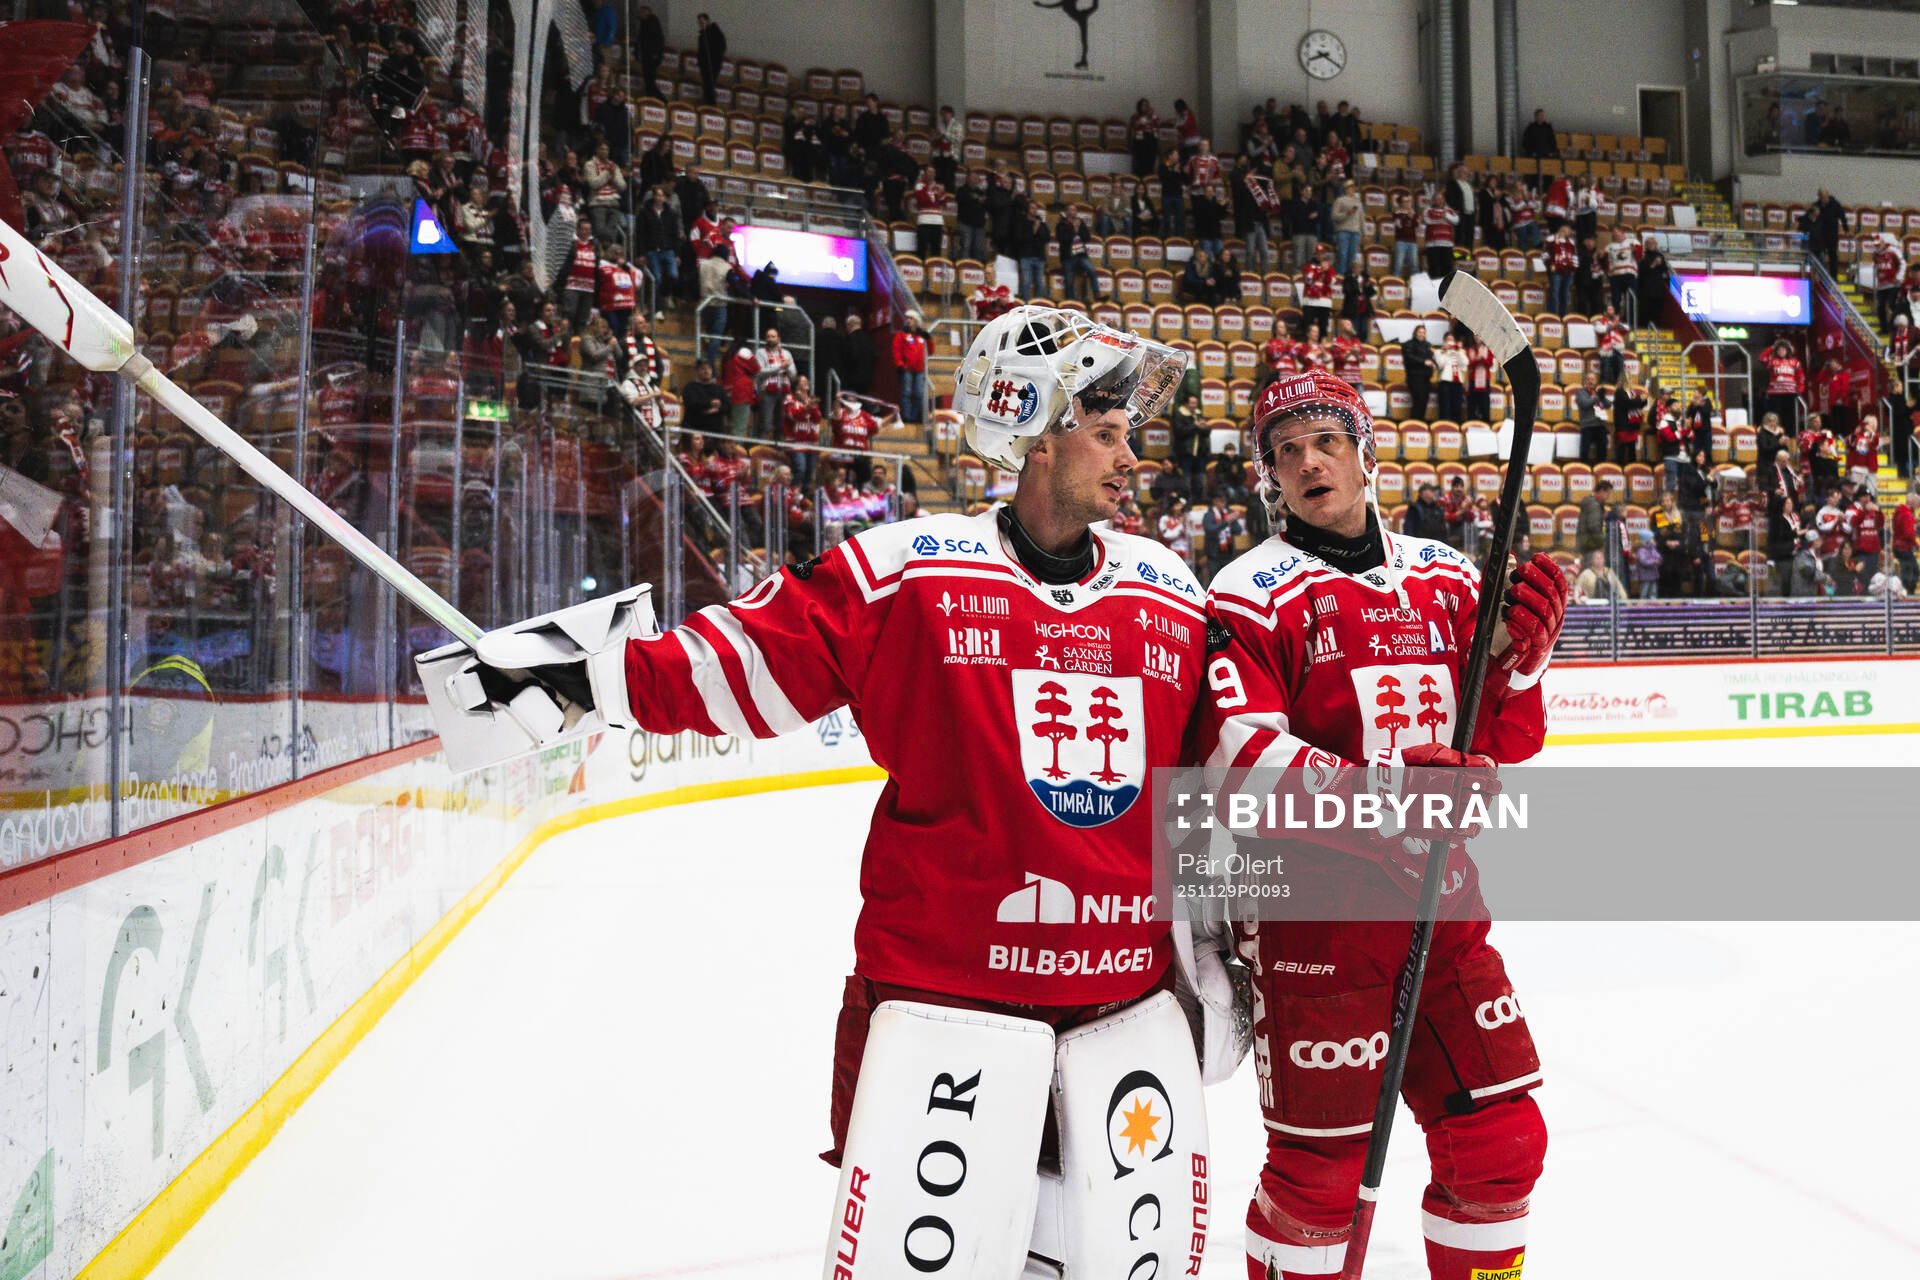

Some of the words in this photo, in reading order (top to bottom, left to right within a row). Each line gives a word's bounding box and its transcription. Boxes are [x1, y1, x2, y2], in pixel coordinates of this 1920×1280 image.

[1280, 380, 1316, 400] LILIUM
[944, 539, 989, 555] SCA
[1272, 556, 1302, 577] SCA
[1161, 573, 1197, 597] SCA
[960, 594, 1010, 615] LILIUM
[1360, 608, 1422, 622] HIGHCON
[1034, 620, 1111, 642] HIGHCON
[1154, 614, 1190, 645] LILIUM
[1391, 633, 1426, 645] SAXNÄS
[1428, 620, 1446, 653] A
[944, 655, 968, 665] ROAD
[971, 656, 1008, 666] RENTAL
[1063, 645, 1112, 662] SAXNÄS
[1315, 651, 1346, 664] RENTAL
[1394, 645, 1428, 656] GÅRDEN
[1064, 658, 1112, 674] GÅRDEN
[1208, 657, 1248, 709] 9
[1728, 690, 1874, 721] TIRAB
[1049, 787, 1095, 816] TIMRÅ
[1098, 795, 1115, 816] IK
[1273, 960, 1336, 976] BAUER
[1185, 1152, 1208, 1277] BAUER
